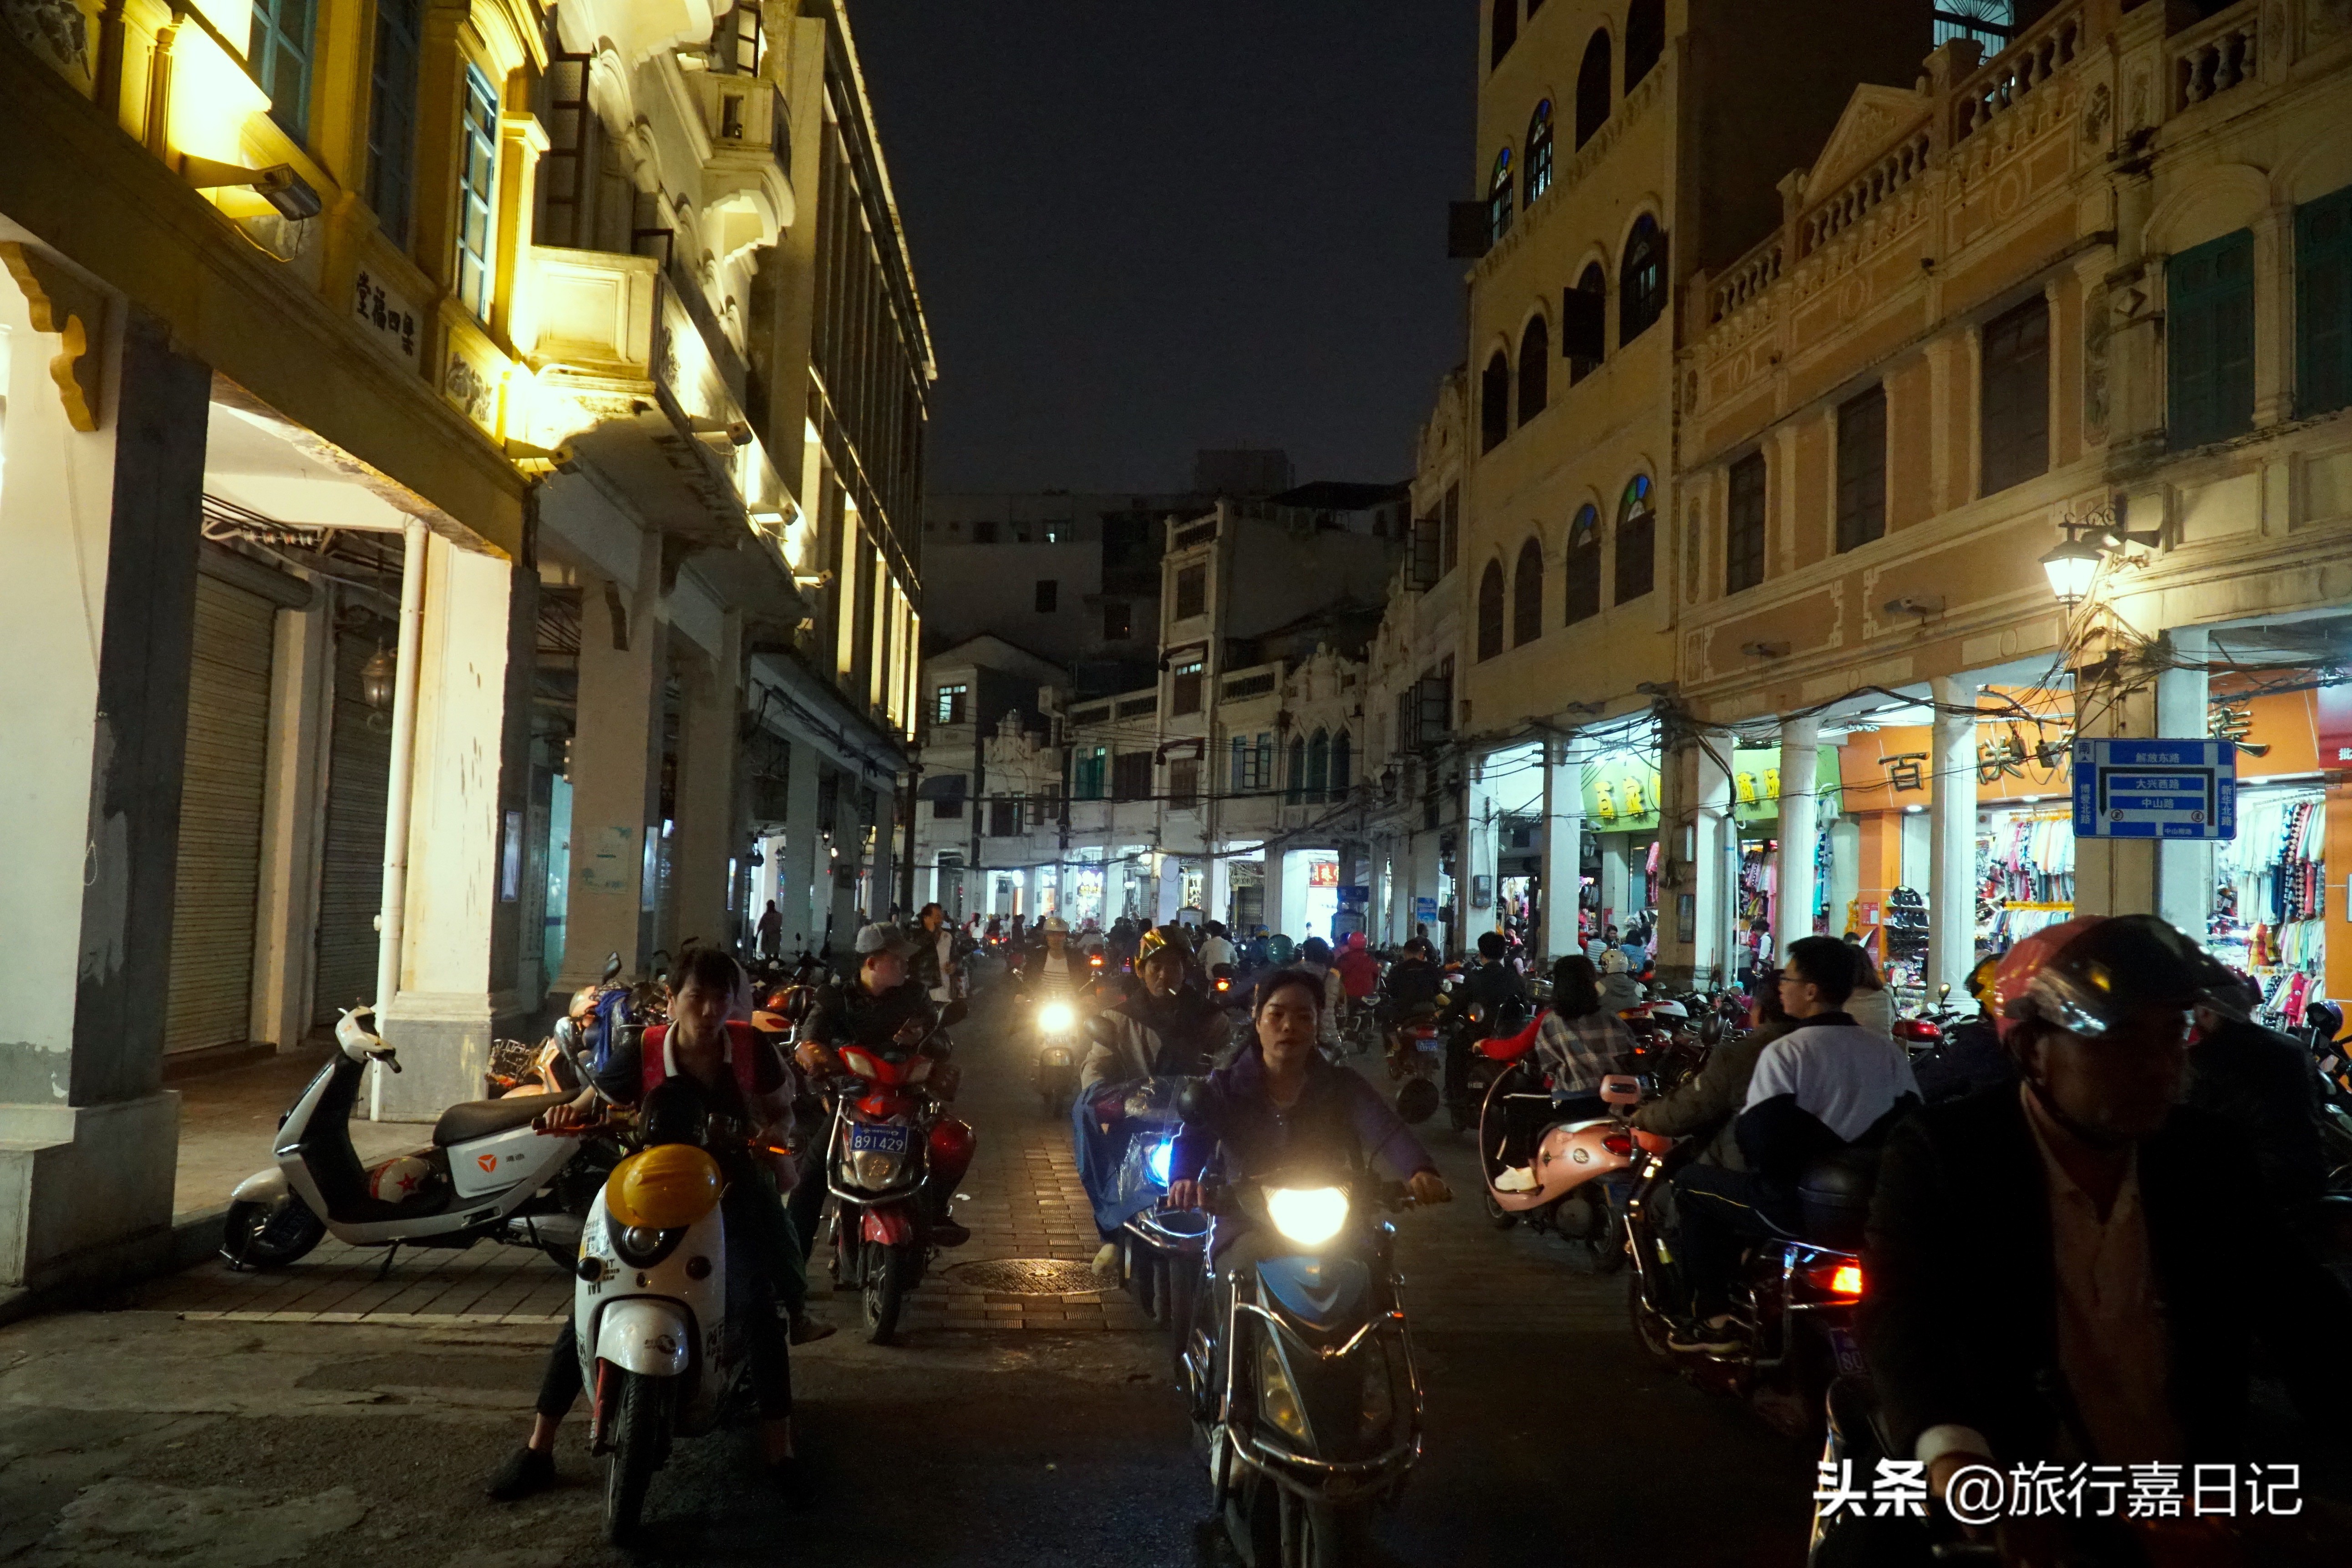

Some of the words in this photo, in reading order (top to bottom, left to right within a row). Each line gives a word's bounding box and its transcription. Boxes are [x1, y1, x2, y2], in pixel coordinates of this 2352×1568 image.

[2078, 742, 2090, 754] 南
[2136, 752, 2179, 763] 解放东路
[2136, 778, 2179, 790] 大兴西路
[2142, 797, 2174, 809] 中山路
[2221, 785, 2233, 826] 新华北路
[854, 1135, 904, 1151] 891429
